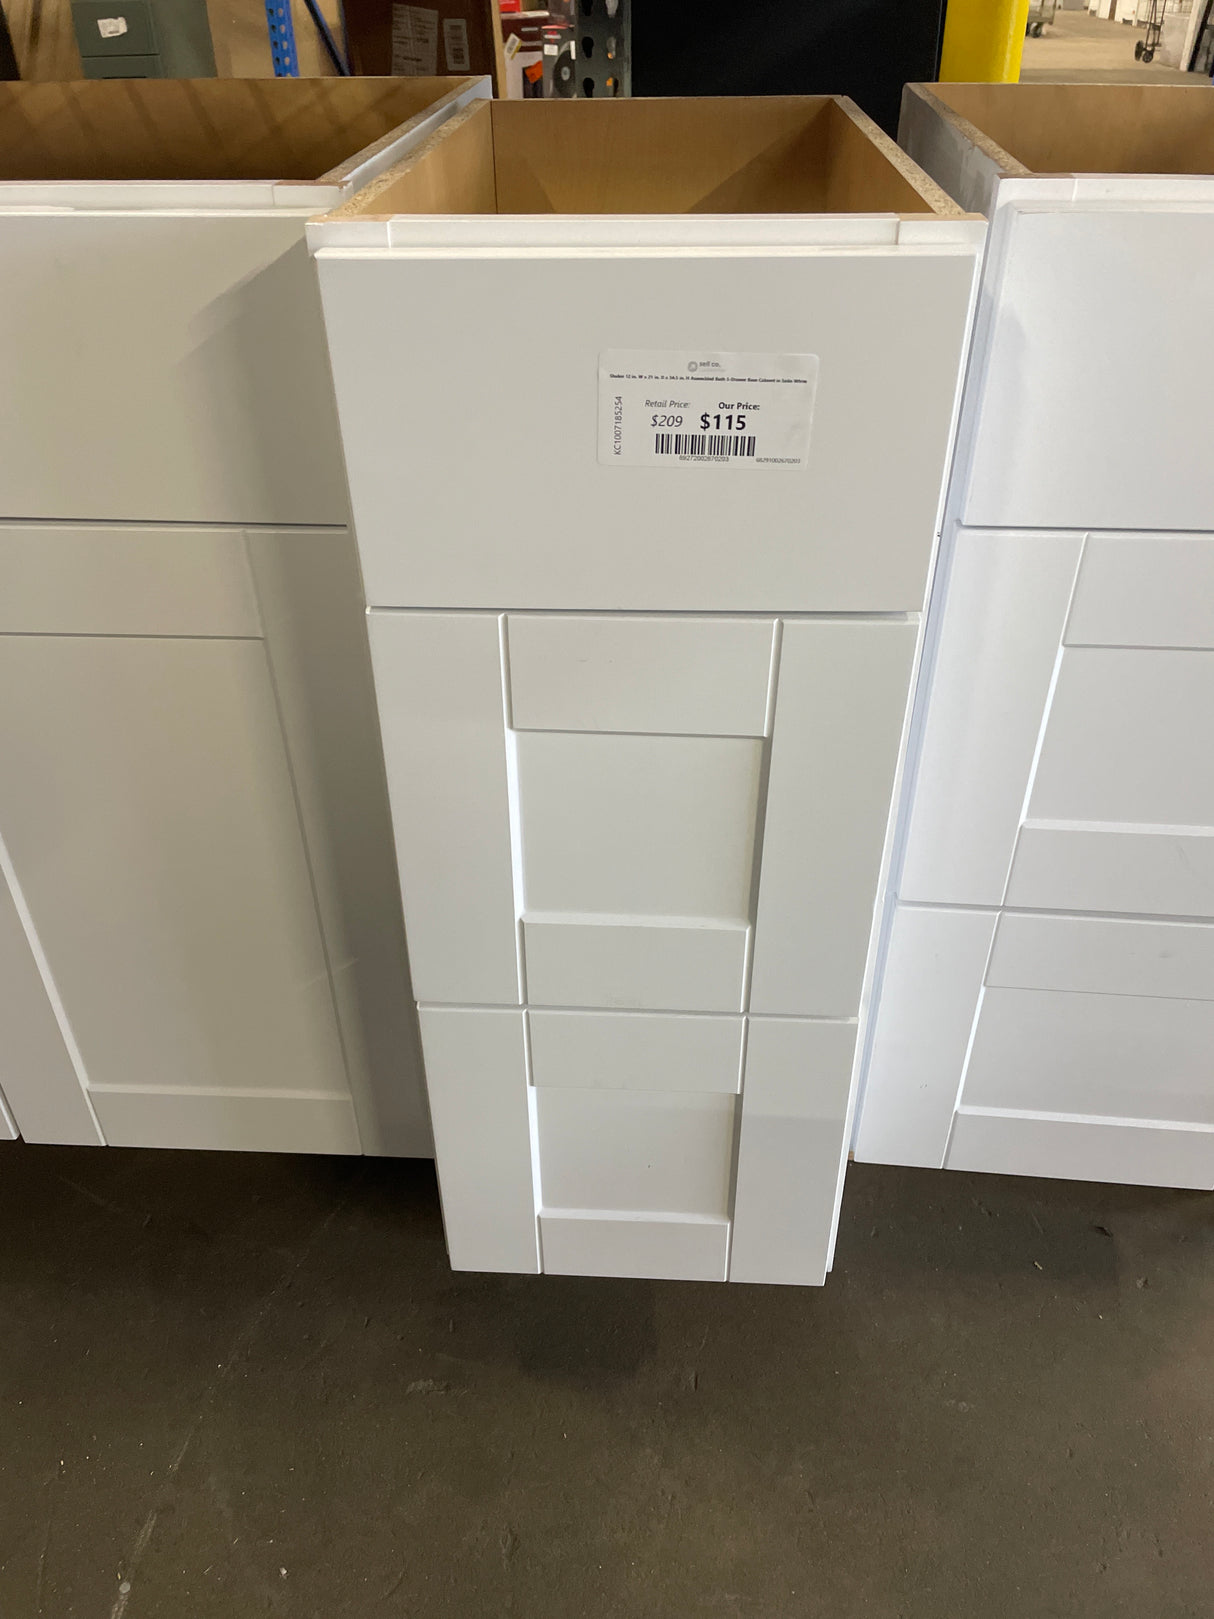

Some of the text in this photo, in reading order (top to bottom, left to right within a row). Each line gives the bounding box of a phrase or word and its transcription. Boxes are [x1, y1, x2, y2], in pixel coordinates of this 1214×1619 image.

[613, 396, 622, 455] KC1007185254
[651, 414, 683, 427] $209
[700, 412, 746, 431] $115
